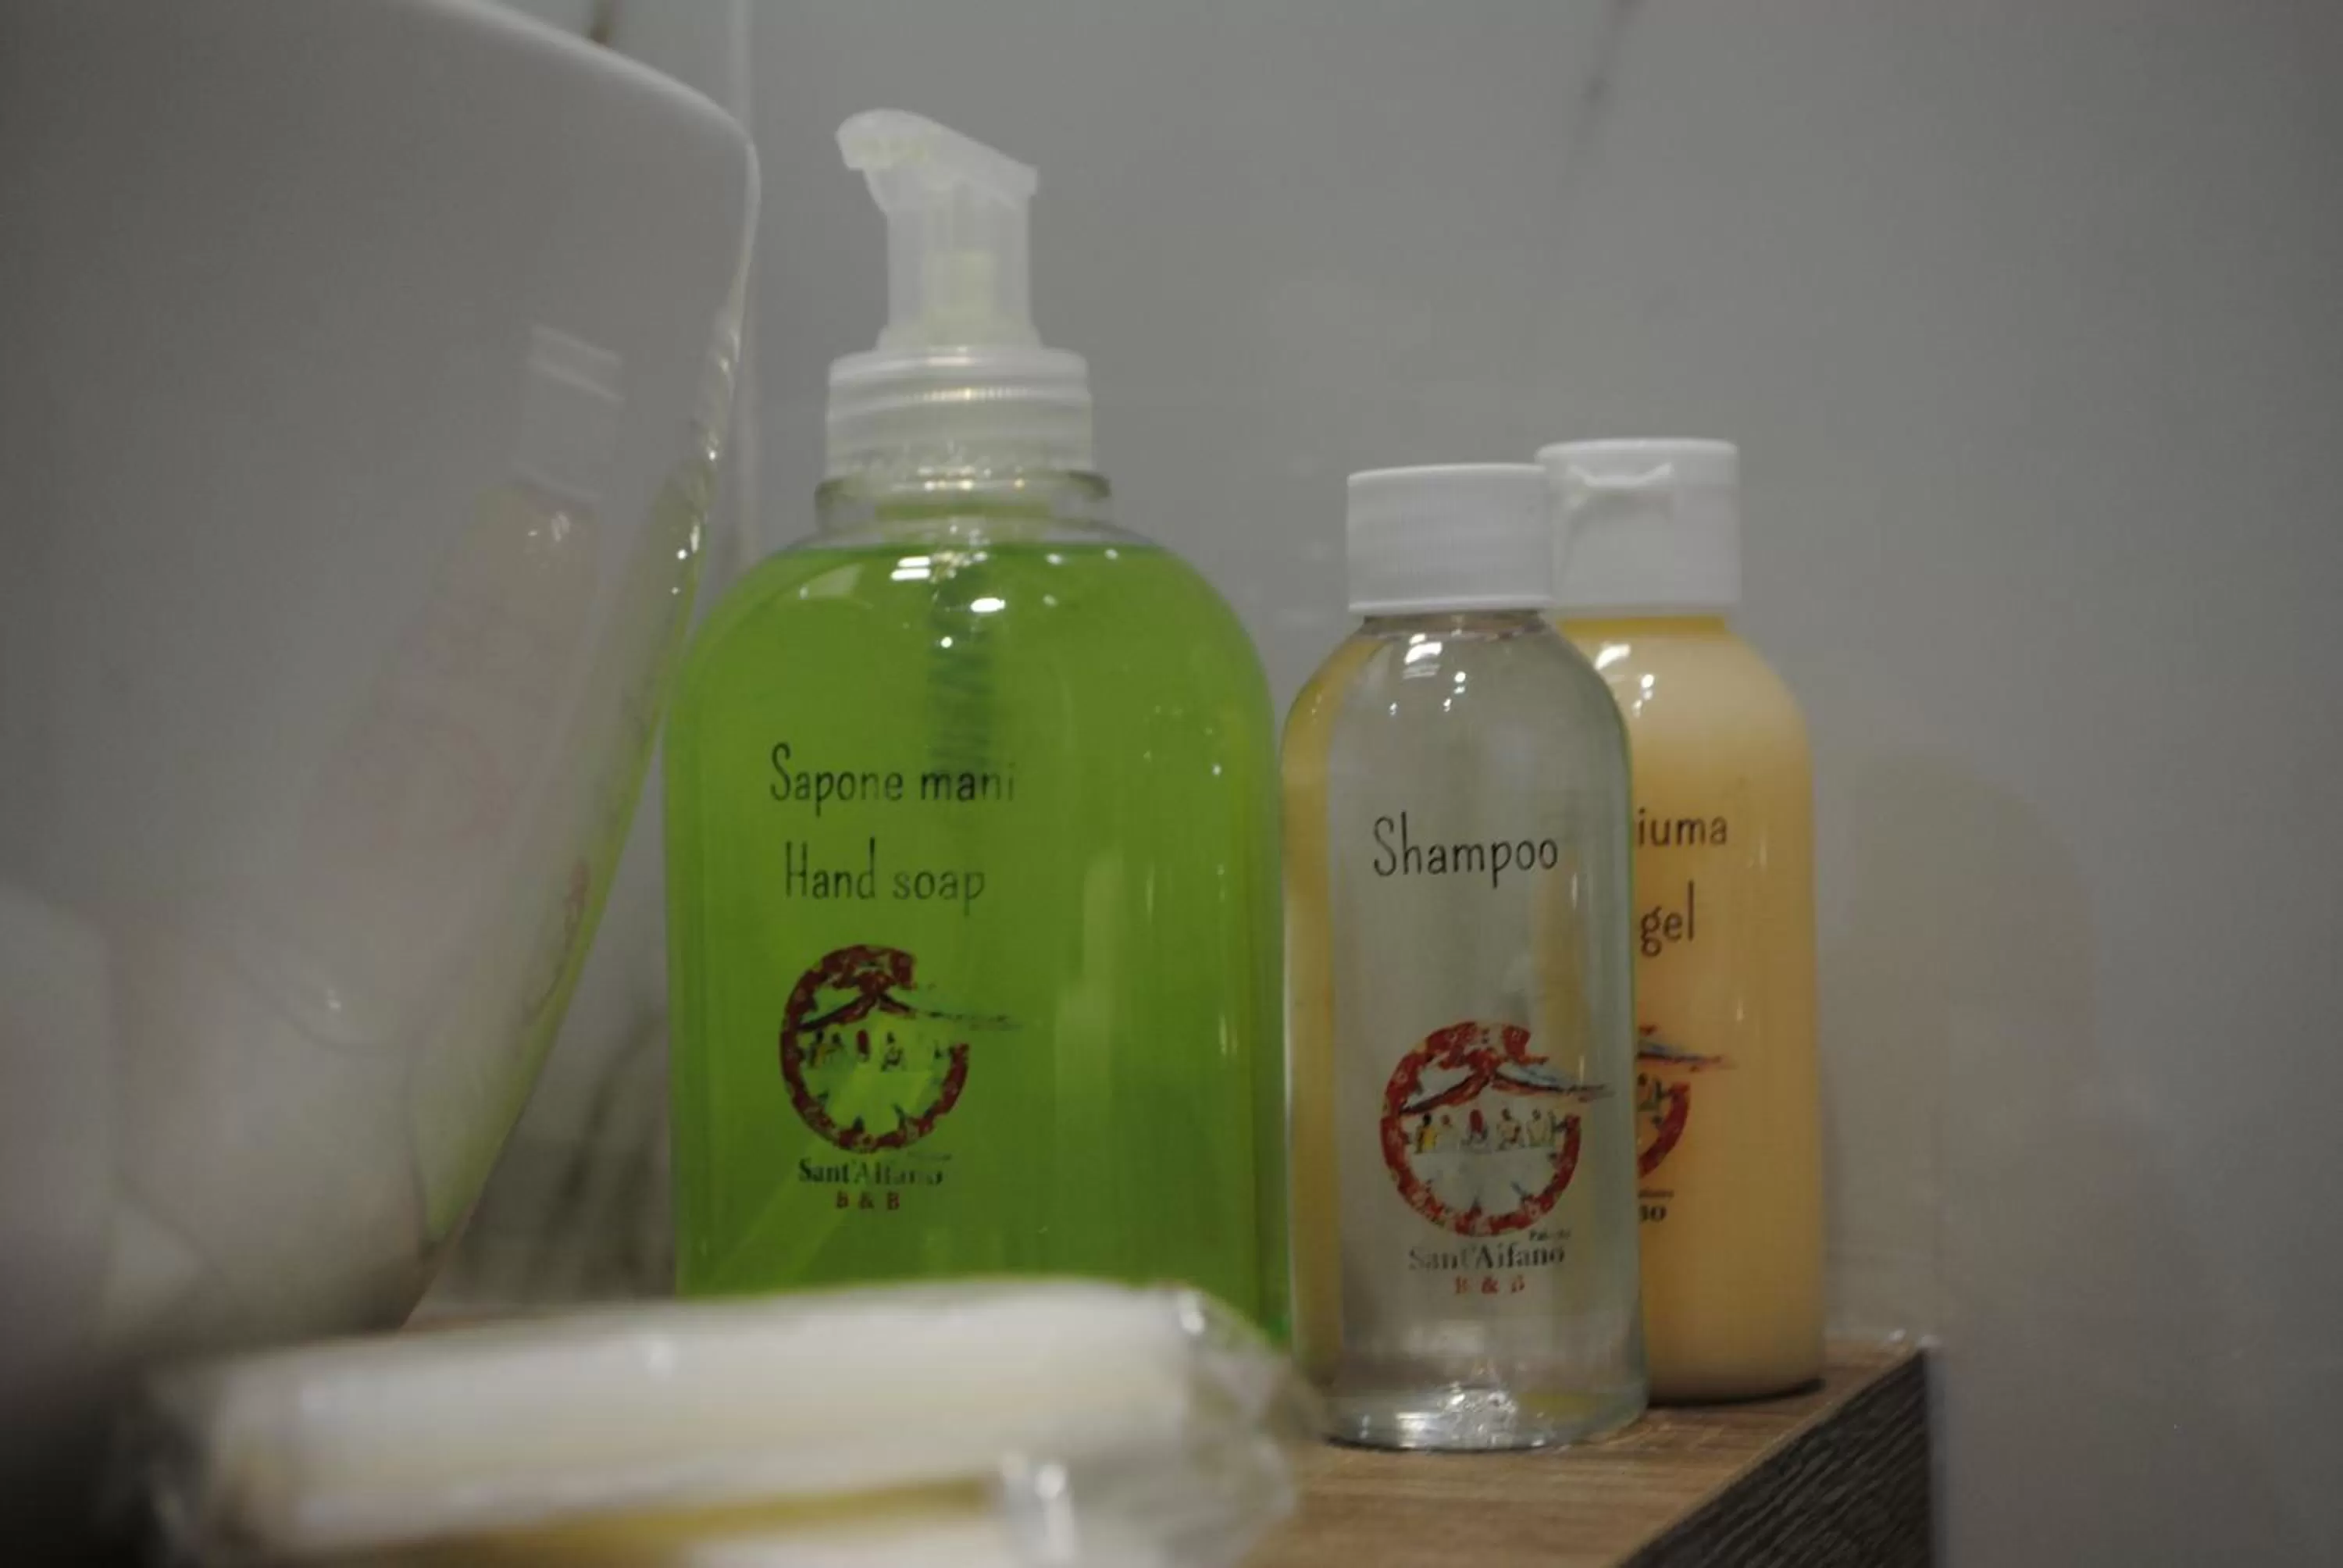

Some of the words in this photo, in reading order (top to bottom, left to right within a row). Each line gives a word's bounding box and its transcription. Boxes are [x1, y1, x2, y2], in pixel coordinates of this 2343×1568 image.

[769, 742, 904, 818] Sapone
[920, 762, 1015, 801] mani
[1371, 811, 1559, 889] Shampoo
[1635, 807, 1728, 848] iuma
[785, 835, 876, 900] Hand
[892, 869, 987, 917] soap
[1640, 878, 1696, 960] gel
